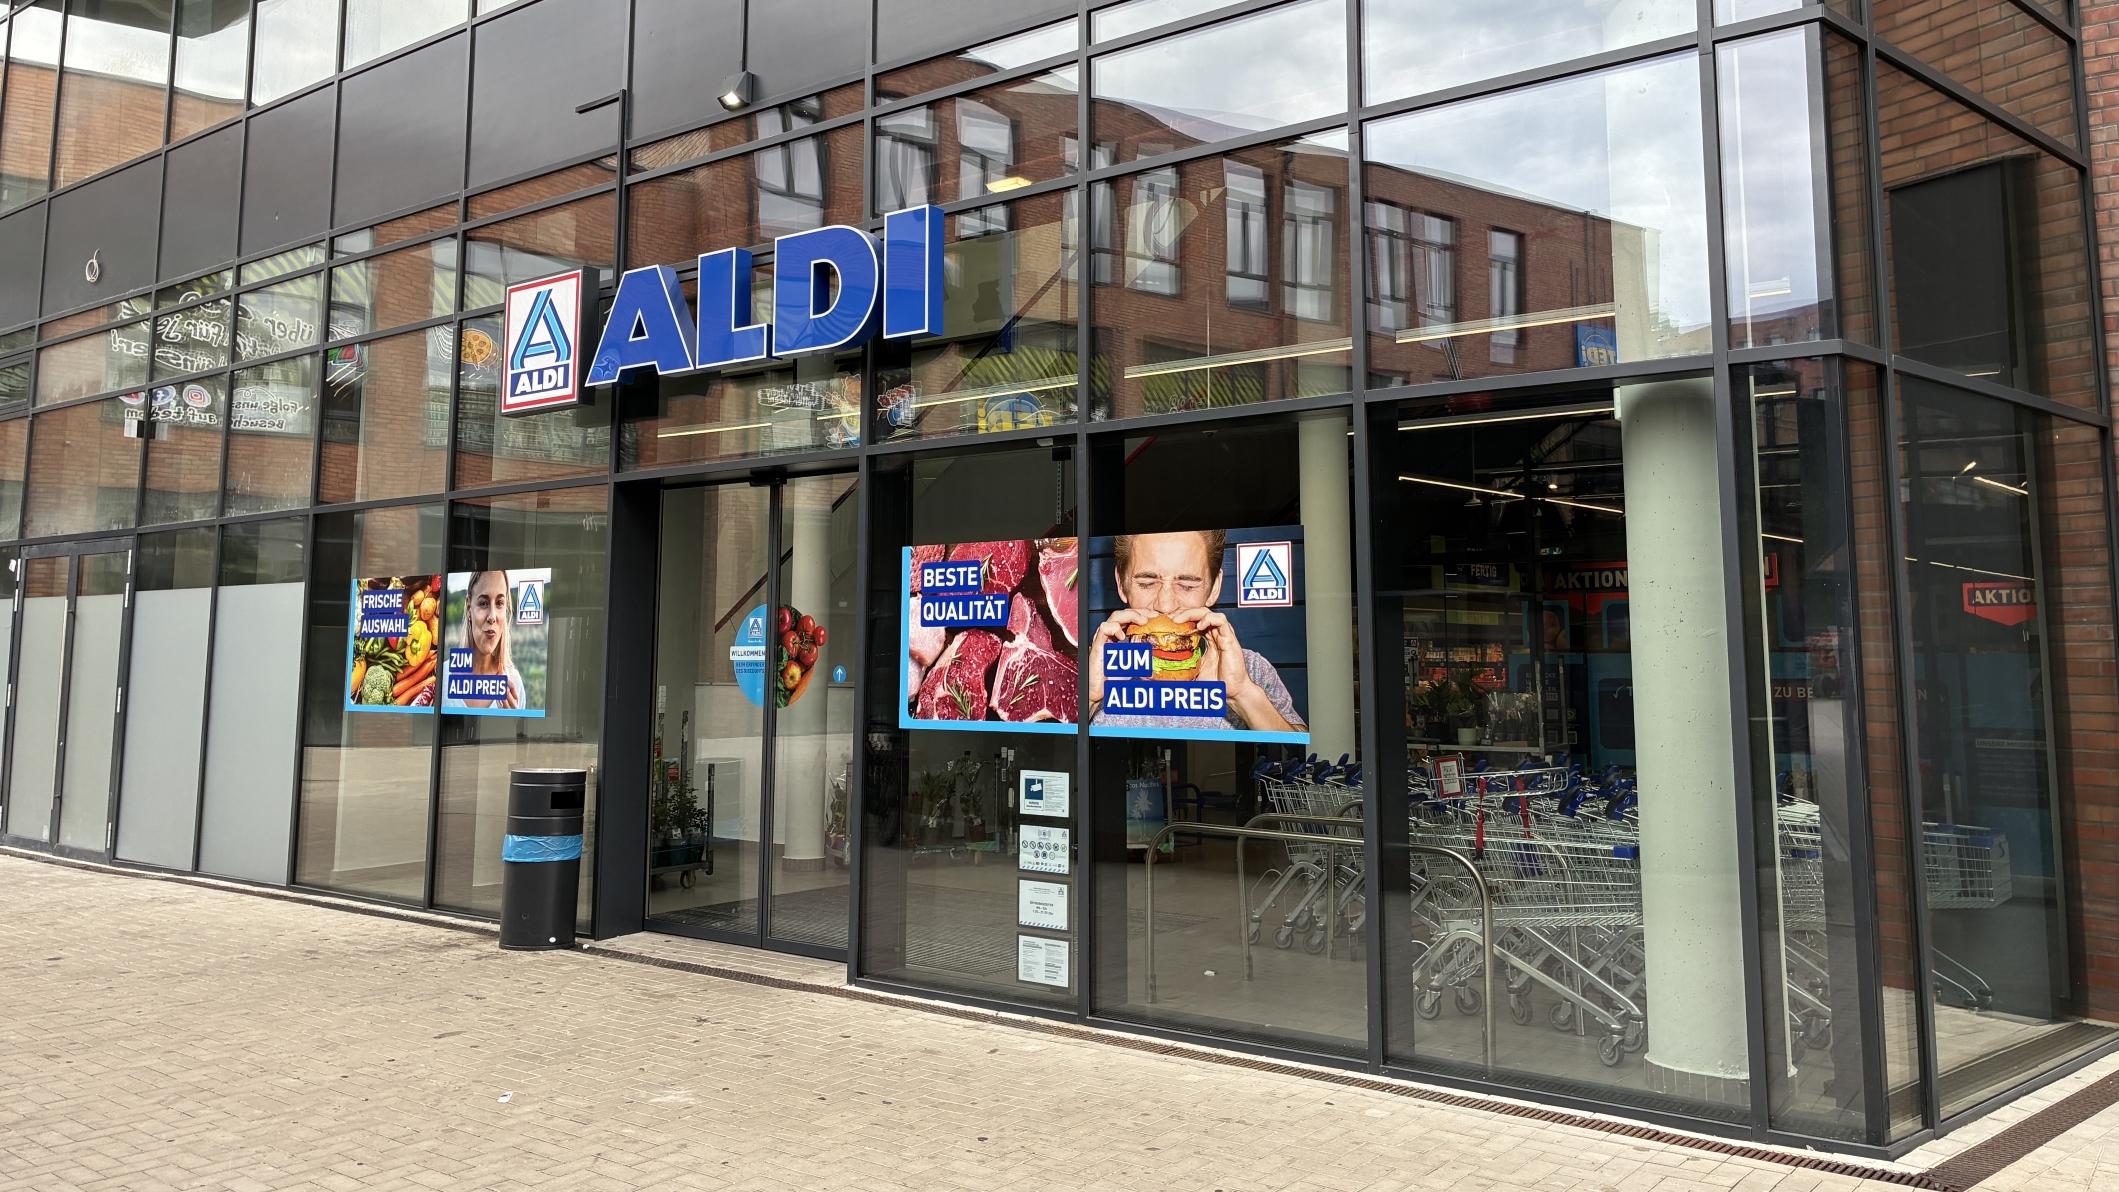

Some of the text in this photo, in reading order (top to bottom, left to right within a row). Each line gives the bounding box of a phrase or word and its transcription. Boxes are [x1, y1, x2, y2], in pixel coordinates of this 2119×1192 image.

[584, 203, 944, 387] ALDI
[514, 366, 566, 396] ALDI
[923, 566, 979, 587] BESTE
[362, 592, 403, 609] FRISCHE
[1247, 588, 1283, 600] ALDI
[1973, 588, 2038, 605] AKTIO
[520, 611, 539, 620] ALDI
[922, 598, 1006, 622] QUALITÄT
[360, 617, 408, 634] AUSWAHL
[450, 652, 473, 668] ZUM
[1106, 648, 1151, 671] ZUM
[449, 679, 507, 695] ALDI PREIS
[1774, 687, 1792, 698] ZU
[1107, 687, 1224, 711] ALDI PREIS
